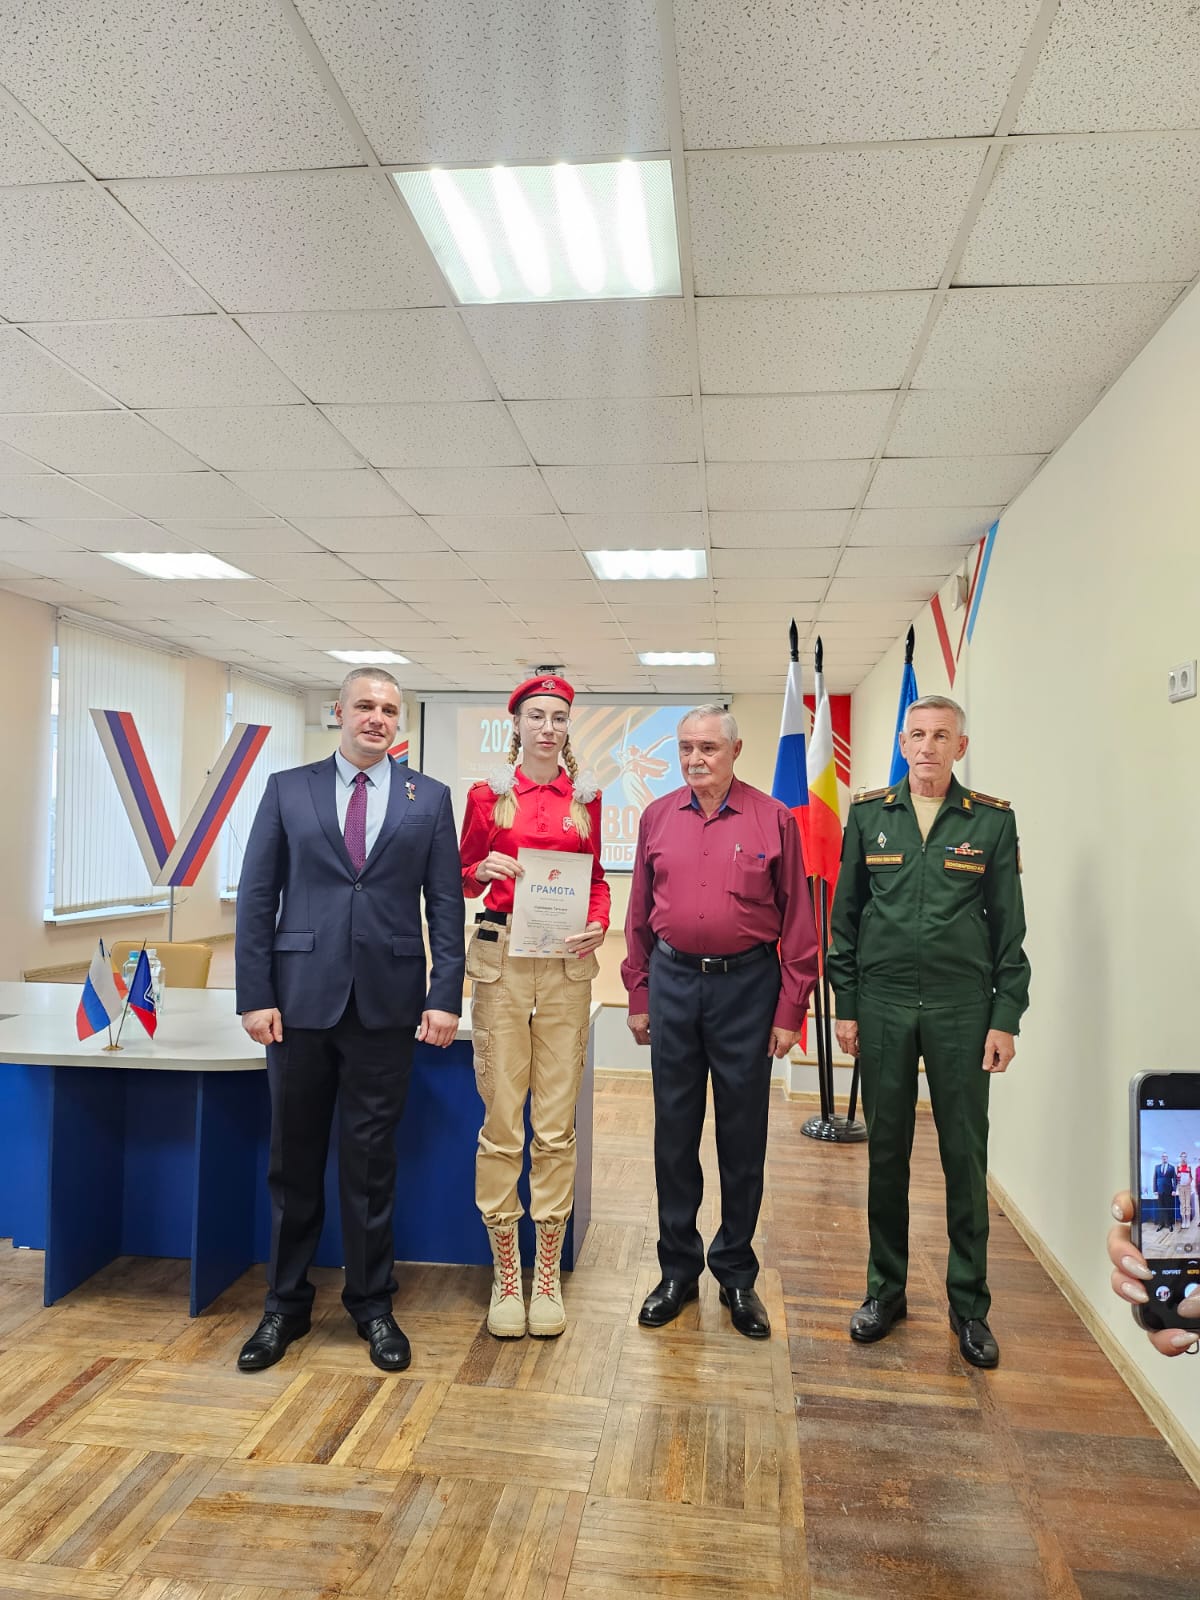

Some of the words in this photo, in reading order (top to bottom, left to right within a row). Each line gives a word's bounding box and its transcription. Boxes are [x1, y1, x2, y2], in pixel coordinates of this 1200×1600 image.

[480, 719, 513, 752] 202
[602, 845, 633, 861] ПОБ
[530, 884, 575, 896] ГРАМОТА
